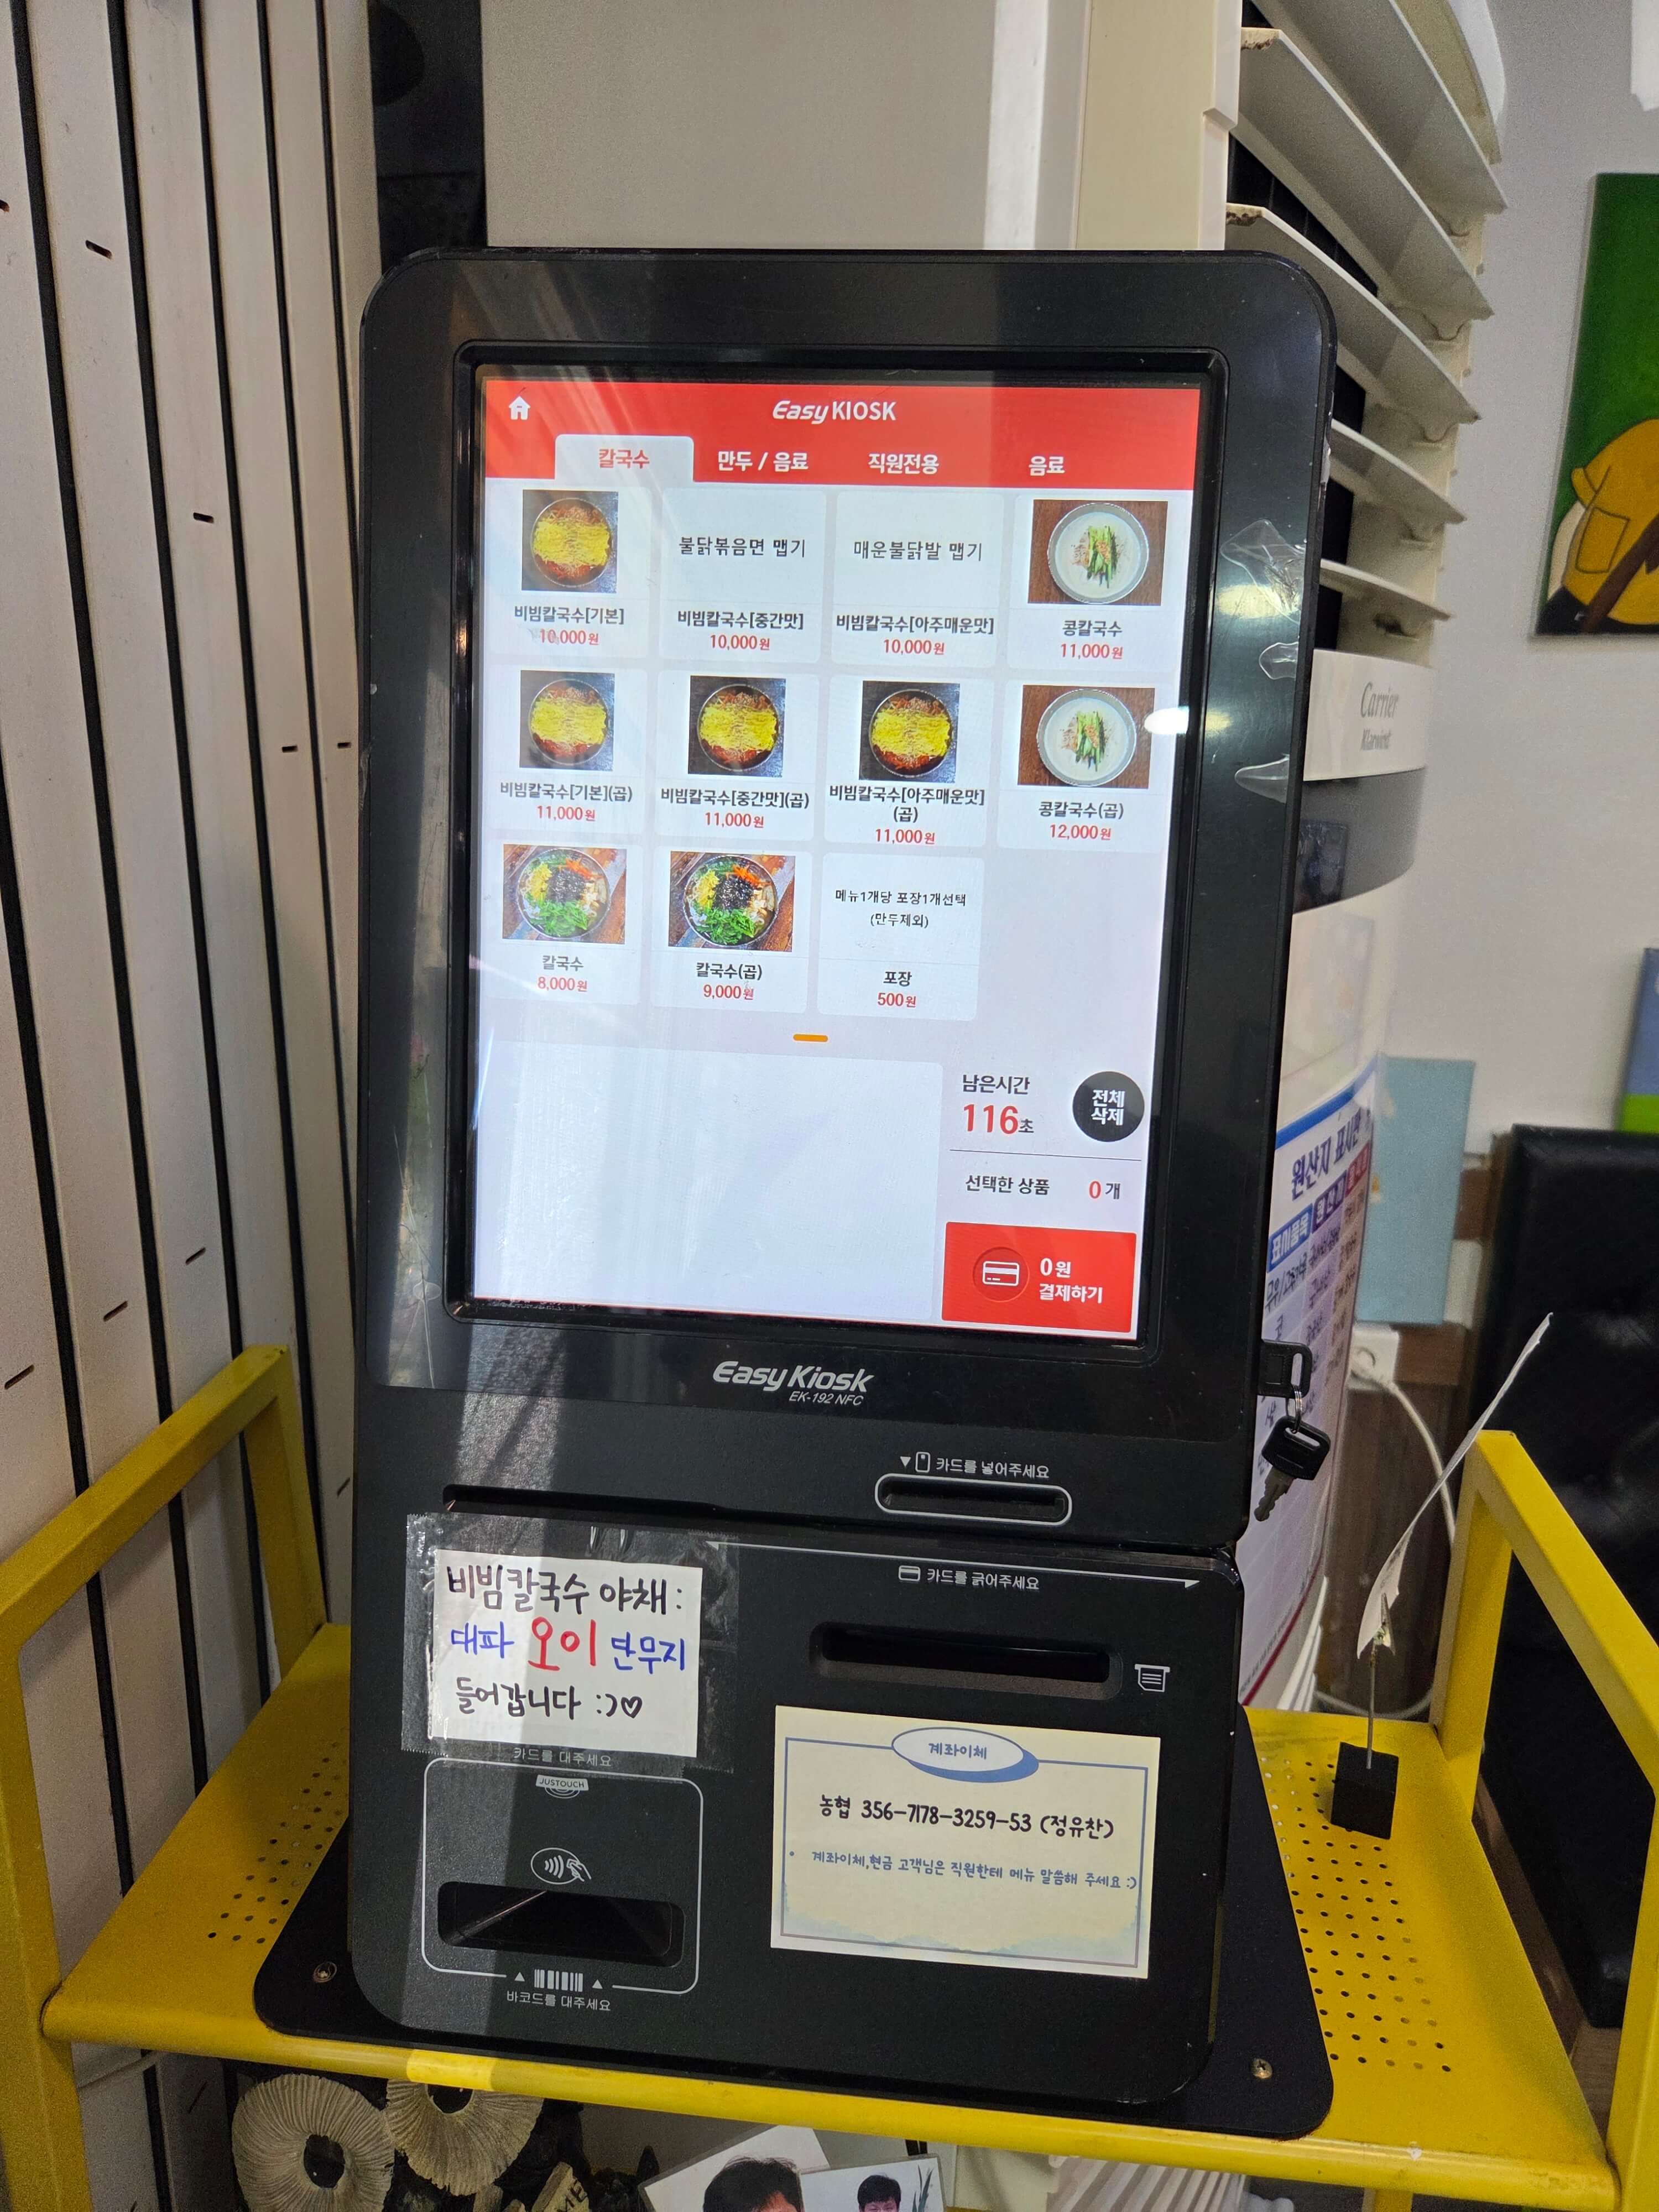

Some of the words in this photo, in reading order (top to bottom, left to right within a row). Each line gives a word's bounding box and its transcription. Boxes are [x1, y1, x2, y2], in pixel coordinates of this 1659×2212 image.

[773, 400, 828, 424] Easy
[832, 401, 896, 421] KIOSK
[598, 448, 650, 469] 칼국수
[718, 451, 753, 471] 만두
[773, 452, 808, 472] 음료
[868, 453, 939, 475] 직원전용
[1029, 456, 1065, 476] 음료
[679, 536, 764, 556] 불닭볶음면
[773, 539, 806, 557] 맵기
[854, 541, 941, 560] 매운불닭발
[950, 543, 982, 561] 맵기
[514, 606, 624, 625] 비빔칼국수[기본]
[678, 611, 804, 630] 비빔칼국수[중간맛]
[837, 615, 994, 635] 비빔칼국수[아주매운맛]
[1062, 620, 1122, 638] 콩칼국수
[710, 634, 770, 651] 10,000원
[883, 639, 945, 656] 10,000원
[1060, 643, 1123, 660] 11,000원
[1360, 681, 1399, 718] Carrier
[500, 781, 633, 803] 비빔칼국수[기본](곱)
[661, 788, 809, 809] 비빔칼국수[중간맛](곱)
[830, 785, 984, 806] 비빔칼국수[아주매운맛]
[537, 805, 596, 822] 11,000원
[705, 812, 764, 829] 11,000원
[893, 806, 919, 823] (곱)
[1039, 801, 1124, 820] 콩칼국수(곱)
[875, 828, 935, 845] 11,000원
[1050, 824, 1111, 841] 12,000원
[836, 889, 892, 905] 메뉴1개당
[896, 891, 966, 907] 포장1개선택
[870, 913, 929, 929] (만두제외)
[542, 954, 584, 972] 칼국수
[696, 962, 763, 980] 칼국수(곱)
[538, 977, 587, 993] 8,000원
[883, 971, 912, 987] 포장
[703, 983, 754, 1000] 9,000원
[877, 993, 916, 1009] 500원
[962, 1074, 1030, 1095] 남은시간
[1092, 1089, 1125, 1107] 전체
[963, 1104, 1034, 1135] 116초
[1091, 1108, 1124, 1126] 삭제
[1291, 1135, 1332, 1202] 원산지
[965, 1175, 1014, 1193] 선택한
[1018, 1178, 1050, 1196] 상품
[1039, 1284, 1103, 1305] 결제하기
[713, 1361, 789, 1391] Easy
[787, 1366, 874, 1392] Kiosk
[789, 1391, 833, 1405] EK-192
[835, 1393, 864, 1406] NFC
[936, 1457, 977, 1474] 카드를
[981, 1460, 1049, 1479] 넣어주세요
[447, 1564, 590, 1614] 비빔칼국수
[927, 1568, 967, 1585] 카드를
[971, 1571, 1039, 1590] 긁어주세요
[451, 1621, 515, 1659] 대파
[528, 1616, 597, 1671] 오이
[611, 1631, 685, 1674] 단무지
[456, 1677, 582, 1720] 들어갑니다
[514, 1747, 554, 1762] 카드를
[559, 1751, 612, 1767] 대주세요
[928, 1742, 987, 1760] 계좌이체
[540, 1778, 585, 1788] JUSTOUCH
[819, 1794, 851, 1818] 농협
[860, 1799, 1032, 1833] 356-7178-3259-53
[1040, 1814, 1114, 1840] (정유찬)
[811, 1850, 892, 1871] 계좌이체,현금
[898, 1858, 945, 1876] 고객님은
[950, 1861, 1003, 1880] 직원한테
[1009, 1867, 1035, 1883] 메뉴
[1040, 1869, 1078, 1886] 말씀해
[1084, 1872, 1120, 1889] 주세요
[507, 1991, 556, 2007] 바코드를
[561, 1995, 612, 2012] 대주세요
